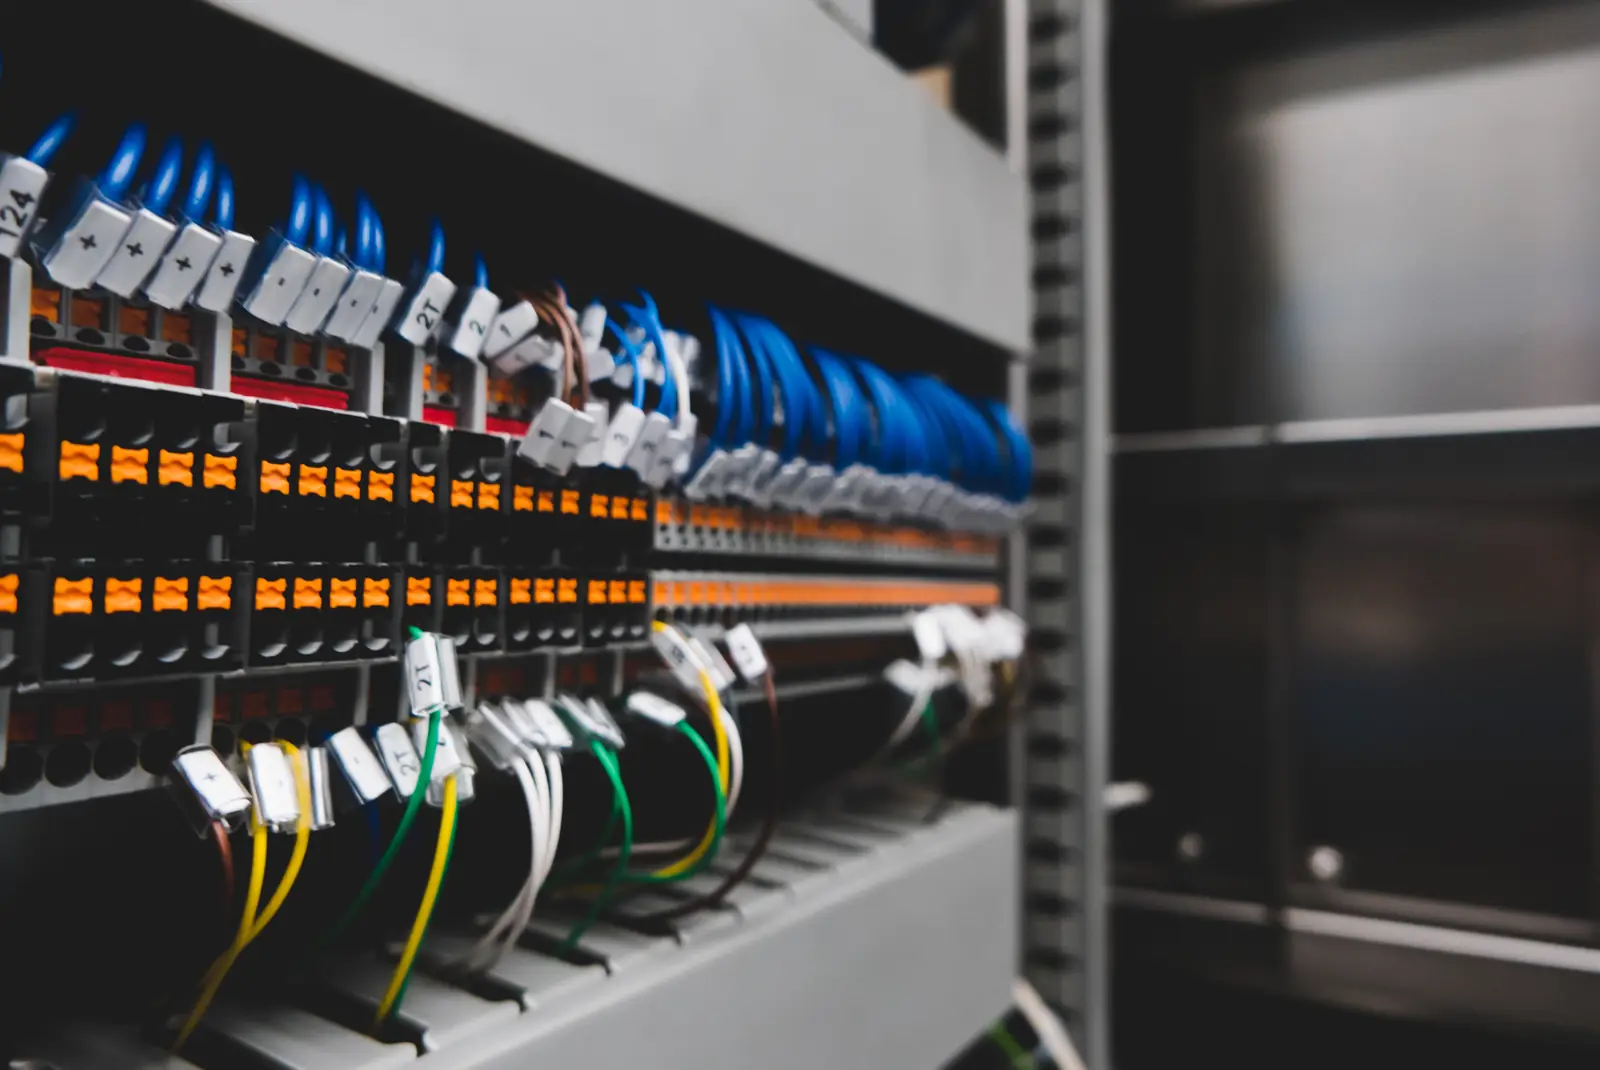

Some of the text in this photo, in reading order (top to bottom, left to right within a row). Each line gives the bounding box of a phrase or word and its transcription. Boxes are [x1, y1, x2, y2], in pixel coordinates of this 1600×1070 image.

[416, 298, 440, 330] 2T
[469, 320, 486, 336] 2
[415, 664, 432, 691] 2T
[394, 751, 418, 776] 2T
